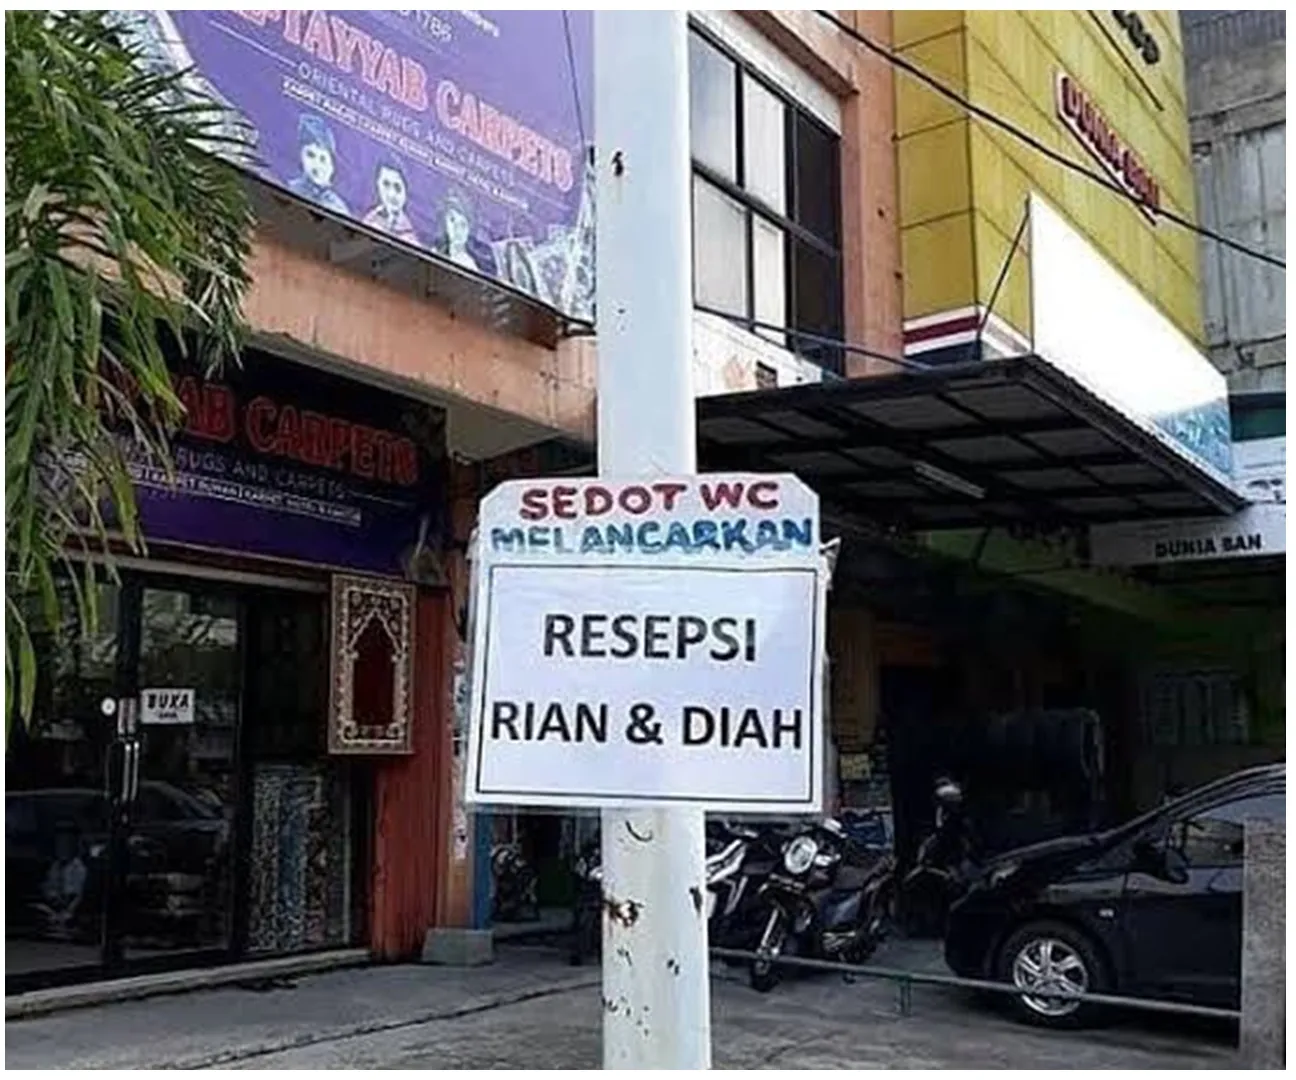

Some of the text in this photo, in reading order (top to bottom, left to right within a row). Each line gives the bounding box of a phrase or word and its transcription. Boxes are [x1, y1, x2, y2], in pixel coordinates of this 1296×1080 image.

[520, 482, 779, 520] SEDOT WC
[1155, 534, 1262, 557] DUNIA BAN
[544, 614, 756, 662] RESEPSI
[491, 702, 802, 749] RIAN & DIAH
